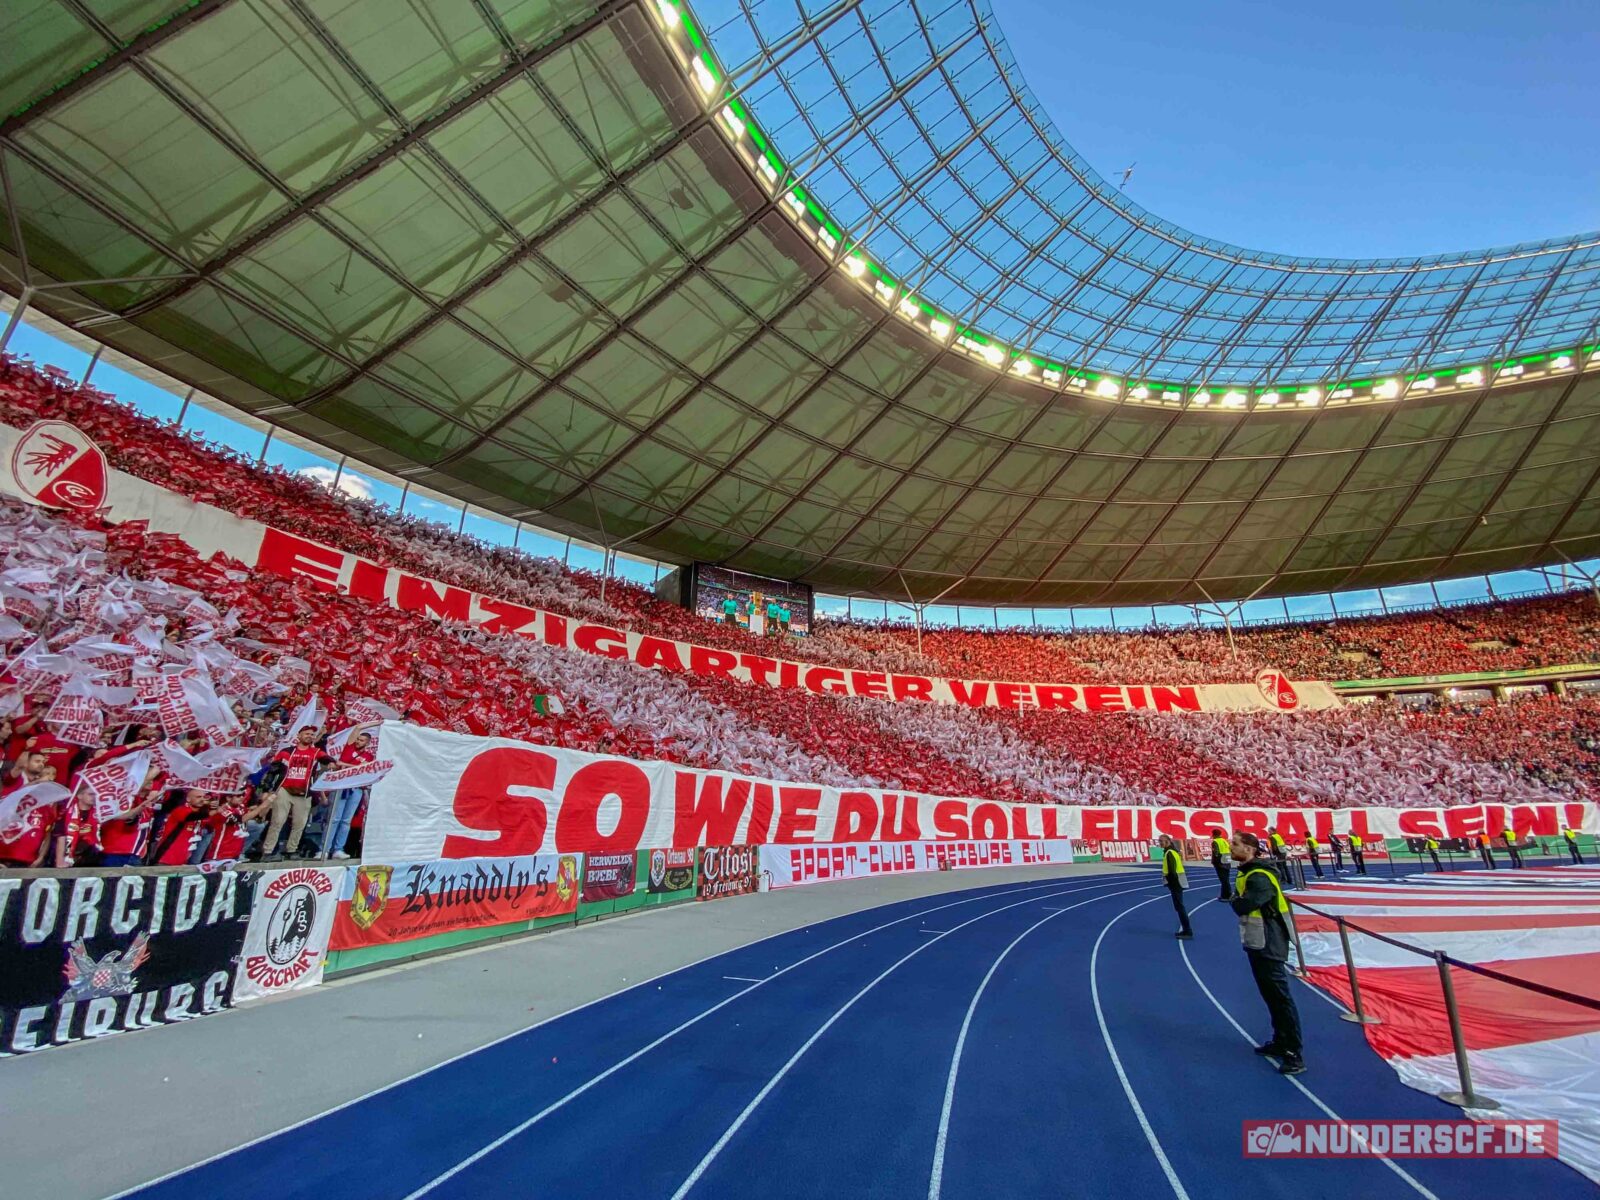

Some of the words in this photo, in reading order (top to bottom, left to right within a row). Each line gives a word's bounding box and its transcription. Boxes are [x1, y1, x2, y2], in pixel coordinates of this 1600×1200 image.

[258, 526, 933, 703] EINZIGARTIGER
[948, 680, 1202, 712] VEREIN
[442, 747, 650, 858] SO
[672, 771, 820, 847] WIE
[832, 792, 920, 843] DU
[933, 799, 1068, 841] SOLL
[1081, 806, 1383, 844] FUSSBALL
[1399, 803, 1585, 839] SEIN!
[264, 869, 333, 899] FREIBURGER
[400, 855, 550, 915] Knaddly's
[704, 846, 753, 880] Tifosi
[790, 844, 916, 882] SPORT-CLUB
[925, 842, 1013, 869] FREIBURG
[246, 949, 320, 987] BOTSCHAFT
[0, 971, 231, 1056] EIBURG
